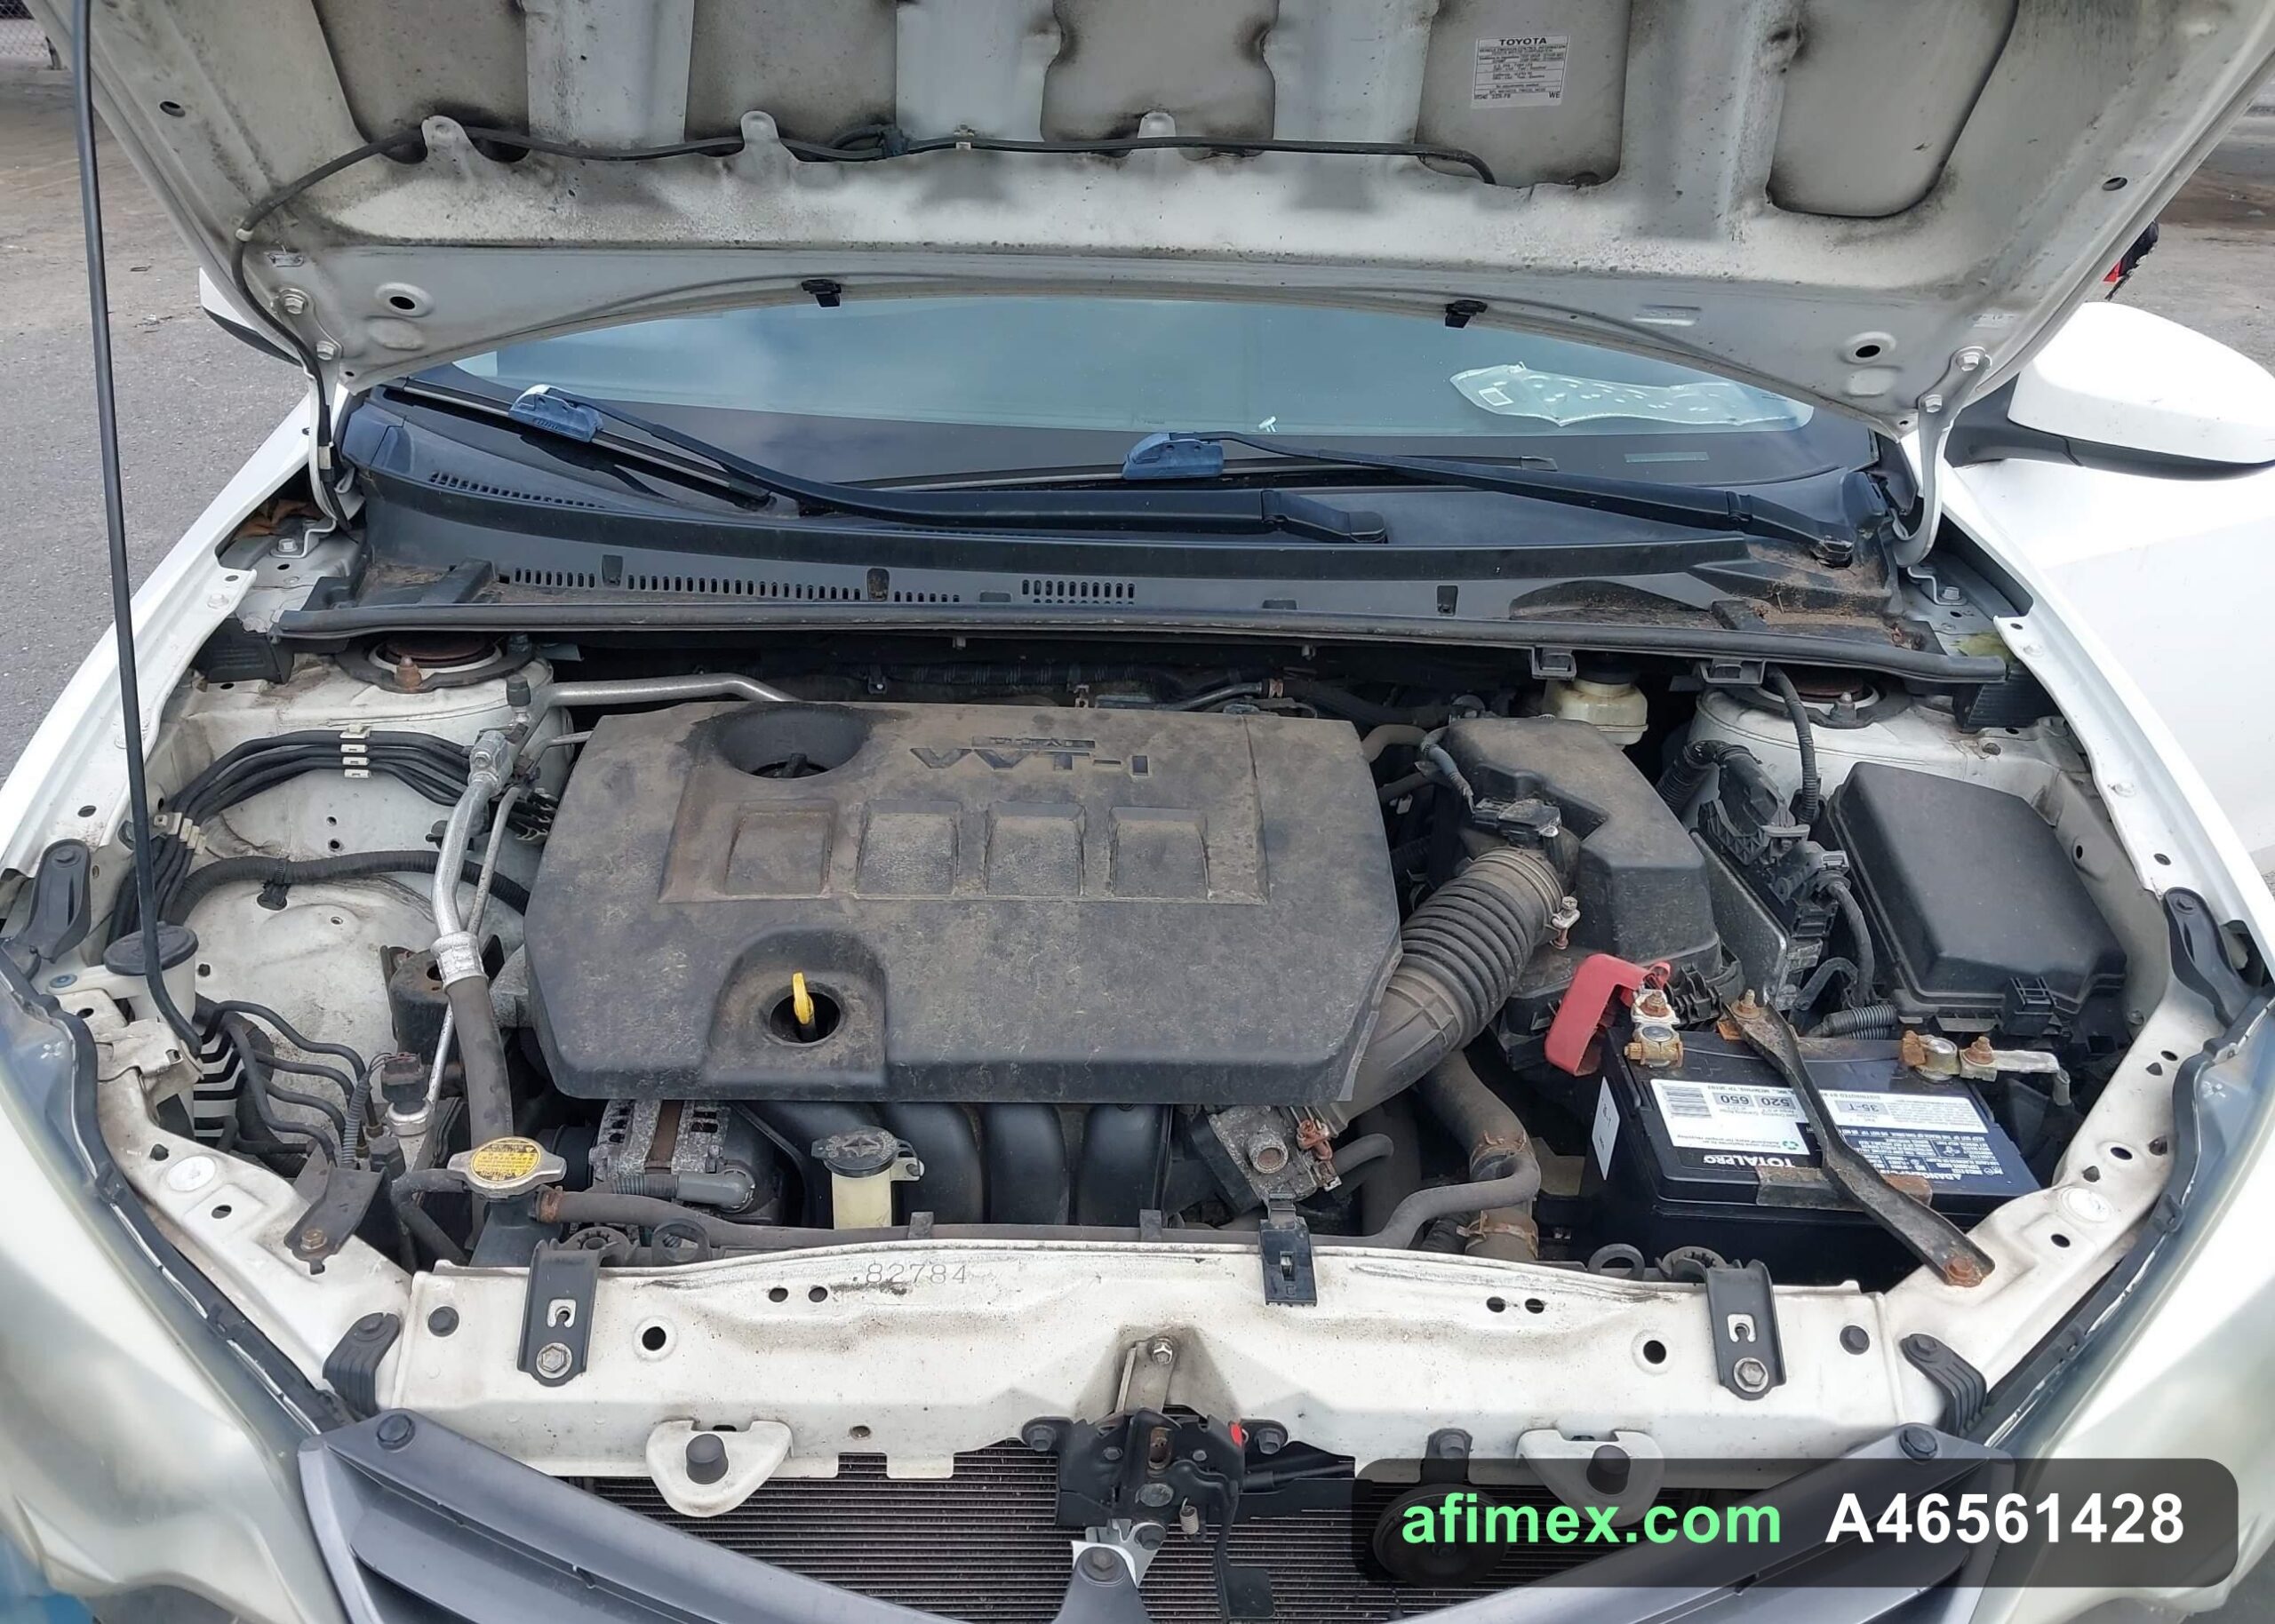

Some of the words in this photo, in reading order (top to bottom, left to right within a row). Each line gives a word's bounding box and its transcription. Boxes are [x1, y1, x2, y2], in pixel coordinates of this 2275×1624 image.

[1499, 37, 1547, 46] TOYOTA
[1720, 1095, 1749, 1105] 650
[1761, 1097, 1790, 1107] 520
[1848, 1103, 1880, 1112] 35-T
[1703, 1155, 1794, 1167] TOTALPRO
[866, 1262, 967, 1285] 82784
